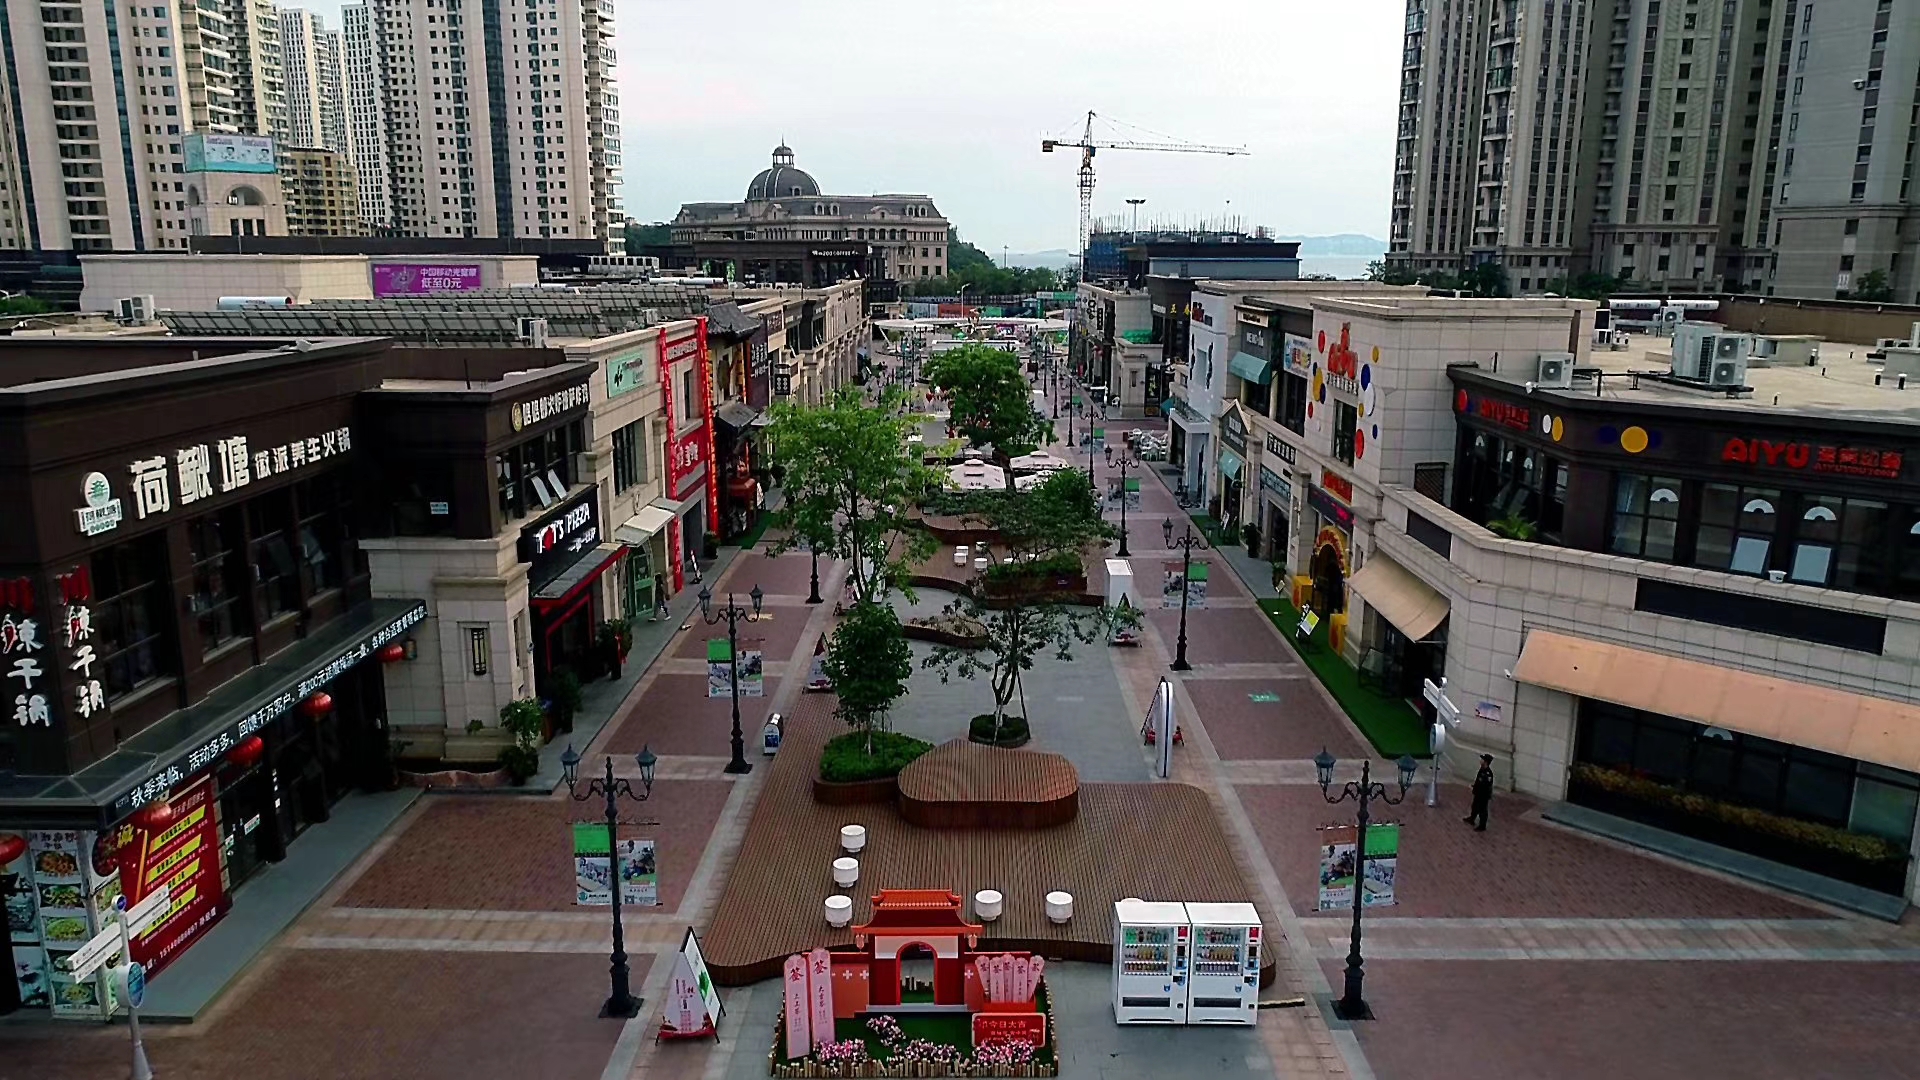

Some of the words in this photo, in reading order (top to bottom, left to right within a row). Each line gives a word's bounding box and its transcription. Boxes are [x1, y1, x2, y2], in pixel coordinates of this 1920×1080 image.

[421, 277, 462, 289] 低至0元
[1722, 436, 1811, 469] AIYU
[566, 502, 591, 534] PIZZA
